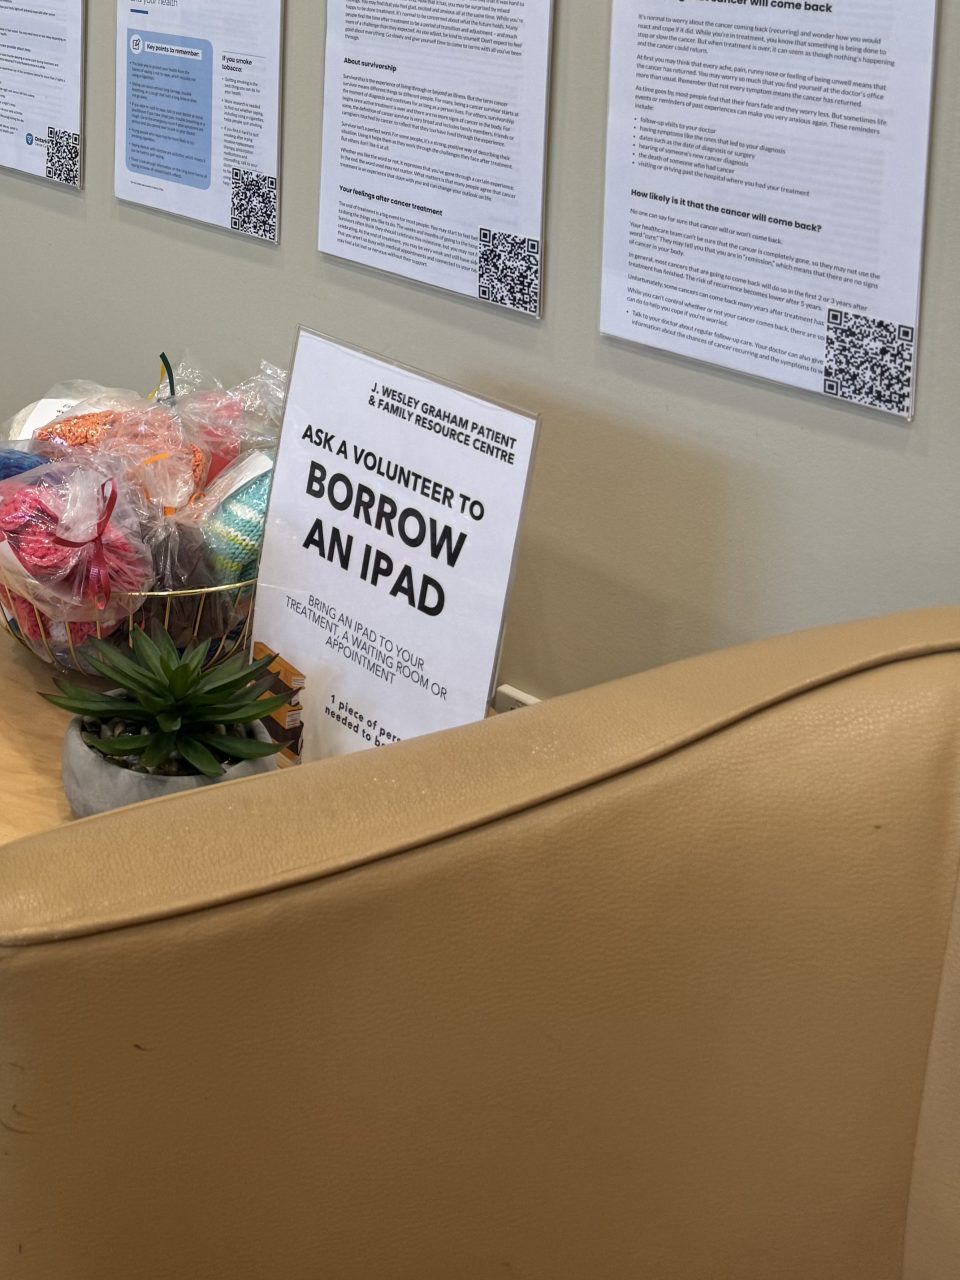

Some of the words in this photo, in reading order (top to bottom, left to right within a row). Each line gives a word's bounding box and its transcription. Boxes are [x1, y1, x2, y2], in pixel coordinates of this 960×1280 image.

[804, 1, 832, 13] back
[368, 396, 375, 407] &
[377, 397, 414, 425] FAMILY
[415, 414, 470, 445] RESOURCE
[473, 438, 515, 465] CENTRE
[372, 382, 380, 395] J.
[381, 384, 420, 409] WESLEY
[421, 400, 468, 430] GRAHAM
[470, 420, 517, 450] PATIENT
[302, 424, 335, 452] ASK
[336, 440, 349, 459] A
[353, 445, 454, 508] VOLUNTEER
[460, 493, 485, 521] TO
[306, 460, 467, 567] BORROW
[303, 518, 354, 570] AN
[360, 544, 445, 616] IPAD
[286, 596, 340, 639] TREATMENT,
[342, 629, 350, 643] A
[351, 634, 394, 670] WAITING
[396, 658, 428, 688] ROOM
[431, 680, 447, 700] OR
[308, 595, 337, 620] BRING
[337, 612, 352, 629] AN
[354, 619, 376, 642] IPAD
[379, 633, 395, 650] TO
[396, 641, 424, 670] YOUR
[326, 637, 395, 684] APPOINTMENT
[325, 706, 359, 733] needed
[362, 729, 371, 741] to
[331, 695, 335, 703] 1
[339, 701, 364, 722] piece
[367, 720, 377, 730] of
